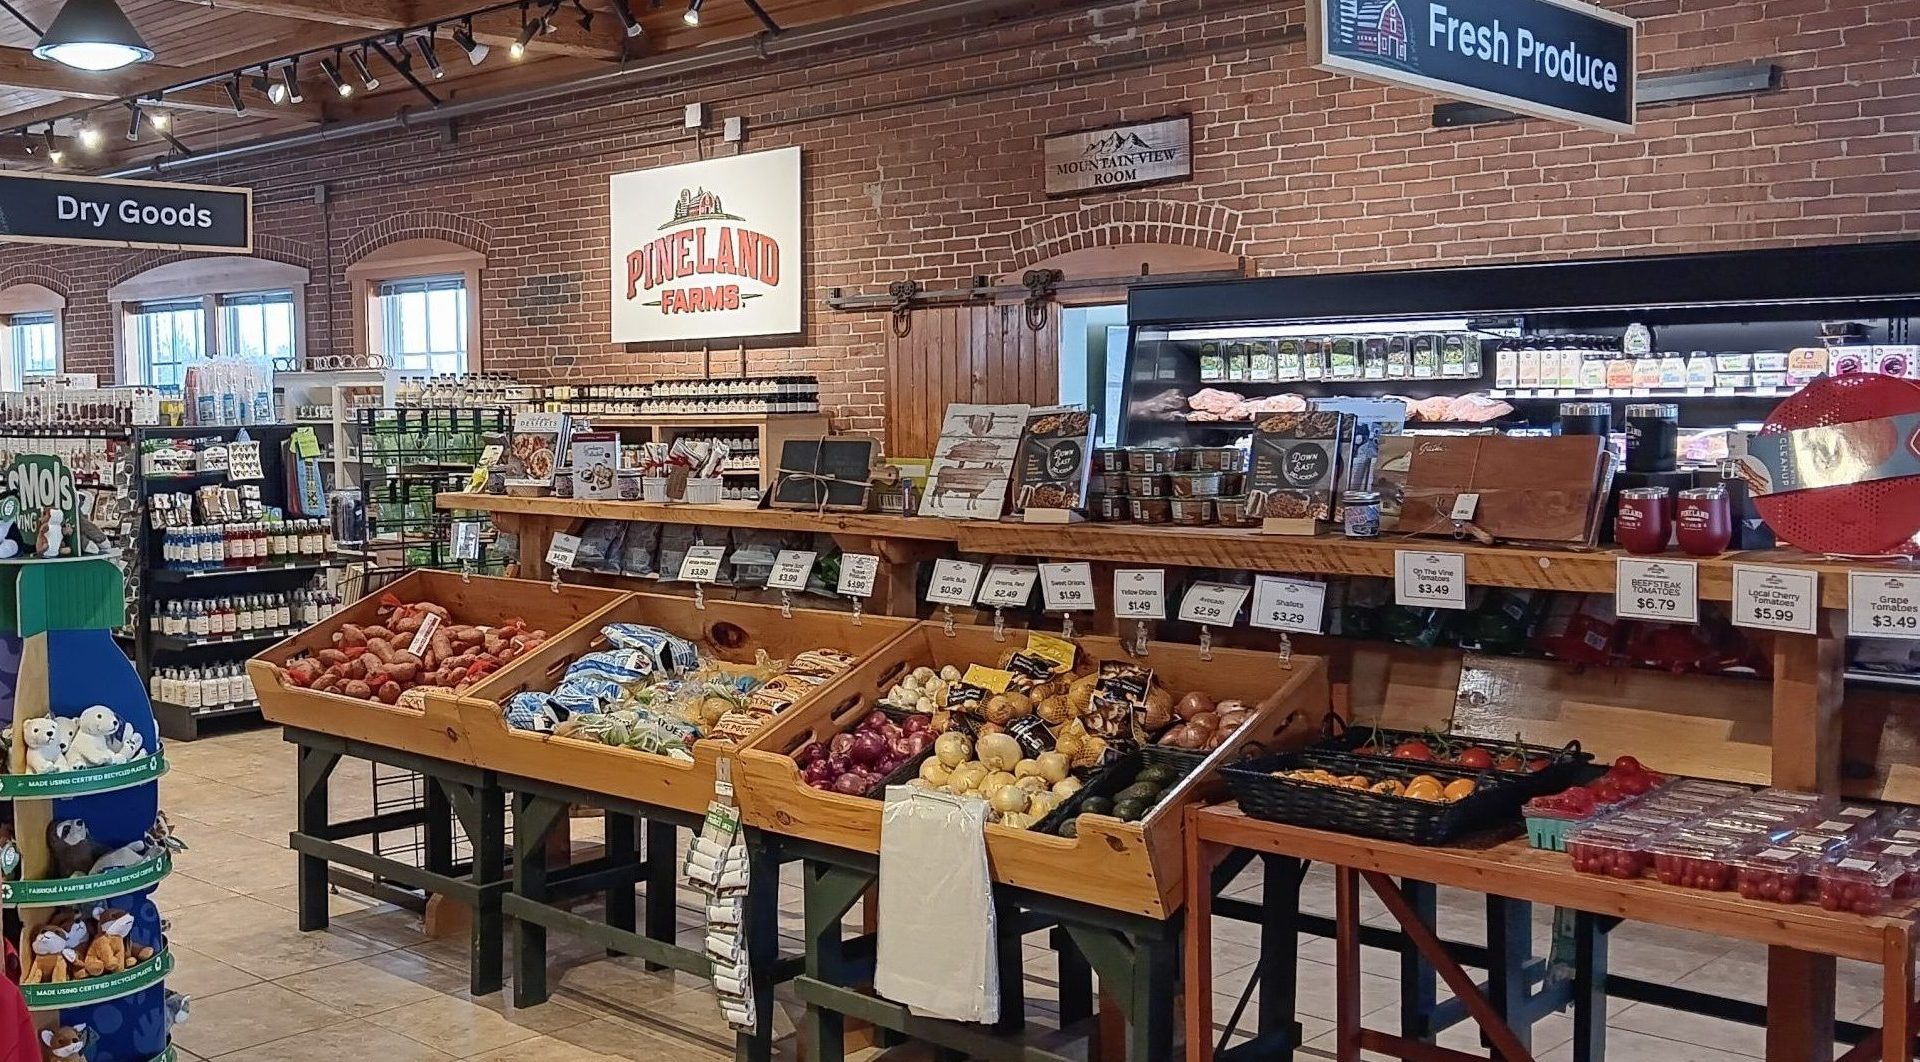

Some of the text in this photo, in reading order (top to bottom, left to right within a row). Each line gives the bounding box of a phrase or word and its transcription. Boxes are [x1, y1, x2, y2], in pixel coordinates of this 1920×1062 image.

[1429, 2, 1618, 93] Fresh Produce
[1056, 148, 1177, 176] MOUNTAIN VIEW
[1094, 169, 1137, 185] ROOM
[57, 195, 213, 228] Dry Goods
[626, 226, 780, 300] PINELAND
[661, 284, 740, 315] FARMS
[1291, 452, 1319, 462] DOWN
[1779, 437, 1790, 486] CLEANUP
[1294, 461, 1316, 473] EAST
[690, 568, 709, 576] $3.99
[778, 573, 798, 583] $3.99
[1417, 574, 1450, 582] Tomatoes
[1423, 568, 1437, 576] The
[1438, 569, 1454, 577] Vine
[1418, 583, 1449, 595] $3.49
[1631, 578, 1681, 589] BEEFSTEAK
[940, 585, 963, 596] $0.99
[994, 589, 1018, 599] $2.49
[1059, 590, 1081, 600] $1.99
[1632, 586, 1680, 597] TOMATOES
[1748, 589, 1800, 602] Local Cherry
[1128, 601, 1151, 611] $1.49
[1275, 598, 1304, 609] Shallots
[1636, 597, 1676, 611] $6.79
[1754, 596, 1795, 607] Tomatoes
[1879, 595, 1909, 605] Grape
[1193, 606, 1221, 618] $2.99
[1870, 602, 1919, 613] Tomatoes
[1272, 611, 1304, 624] $3.29
[1754, 607, 1794, 622] $5.99
[1872, 614, 1917, 628] $3.49
[71, 774, 103, 784] CERTIFIED
[103, 769, 131, 780] RECYCLED
[63, 884, 85, 892] PARTIR
[93, 879, 121, 889] PLASTIQUE
[57, 987, 78, 995] USING
[79, 982, 110, 992] CERTIFIED
[110, 975, 136, 987] RECYCLED
